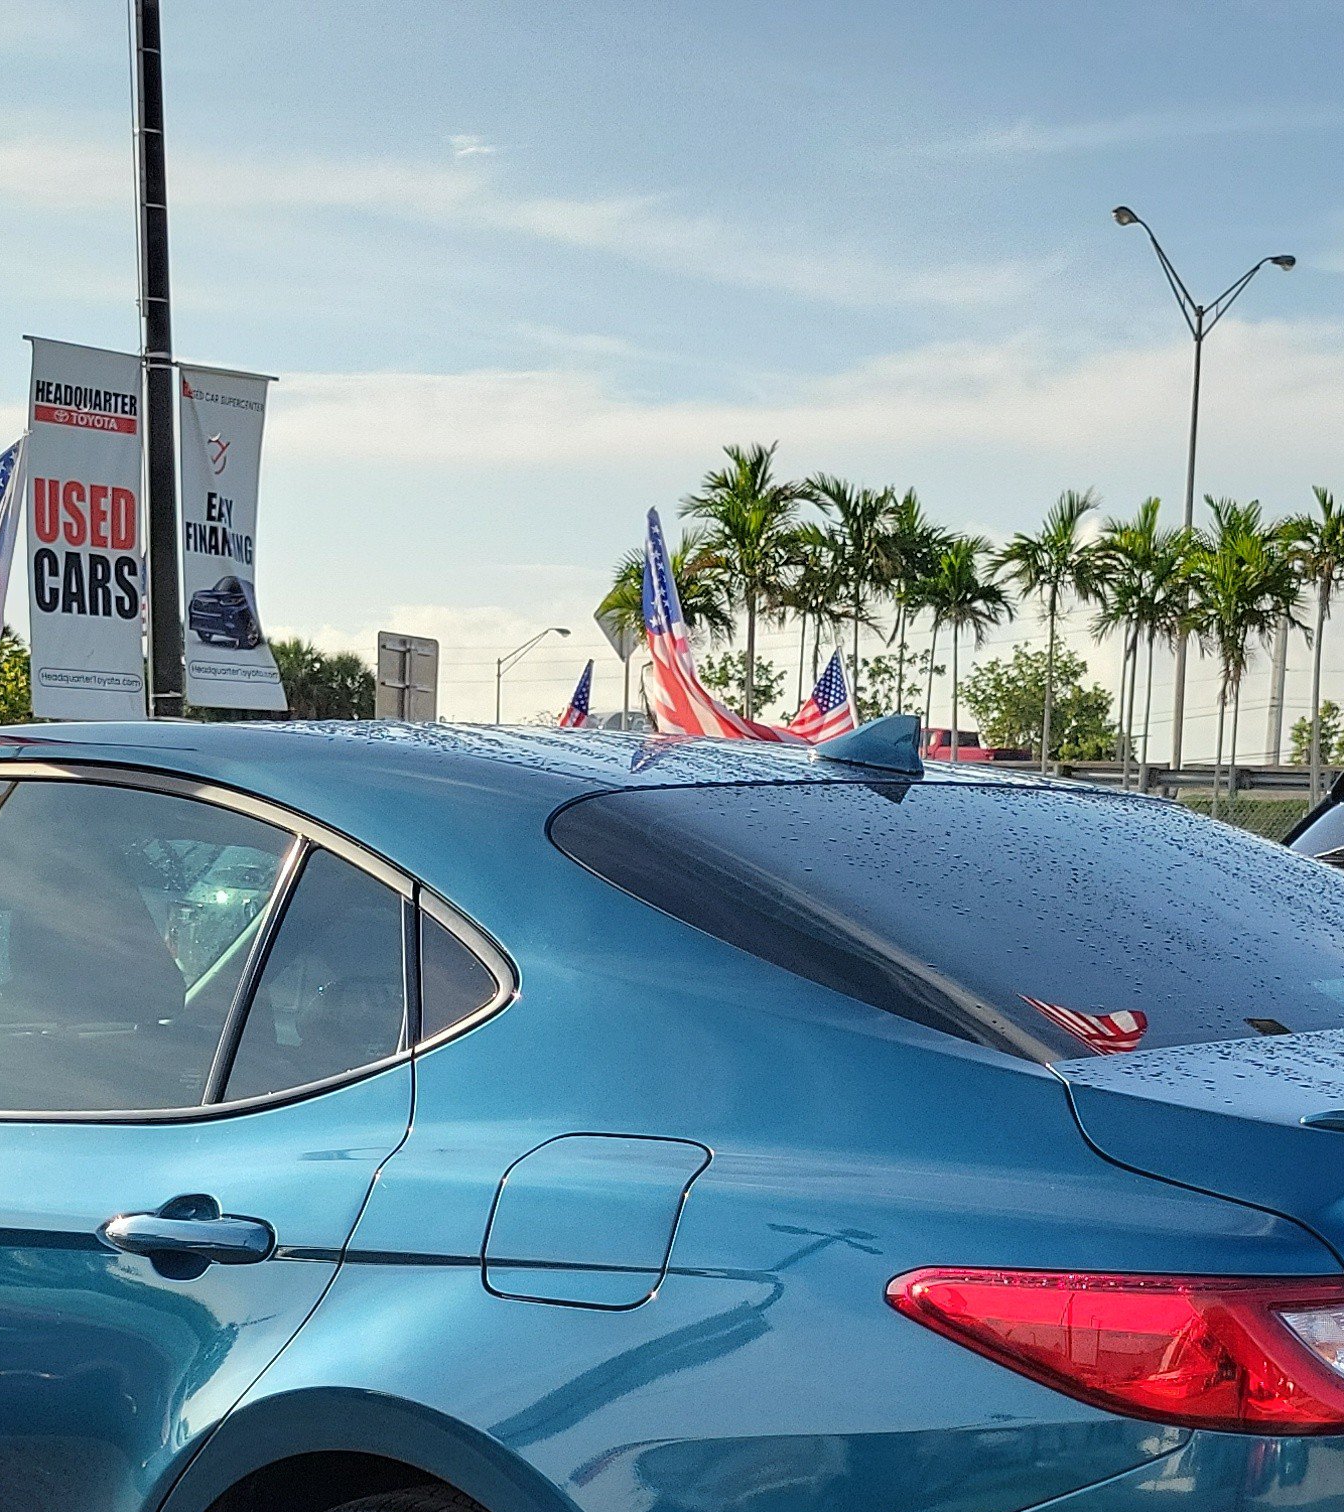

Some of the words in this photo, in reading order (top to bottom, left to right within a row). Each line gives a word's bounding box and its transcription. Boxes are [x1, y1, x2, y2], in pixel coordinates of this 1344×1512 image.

[35, 379, 138, 417] HEADQUARTER
[70, 412, 118, 430] TOYOTA
[34, 477, 136, 551] USED
[33, 546, 140, 620] CARS
